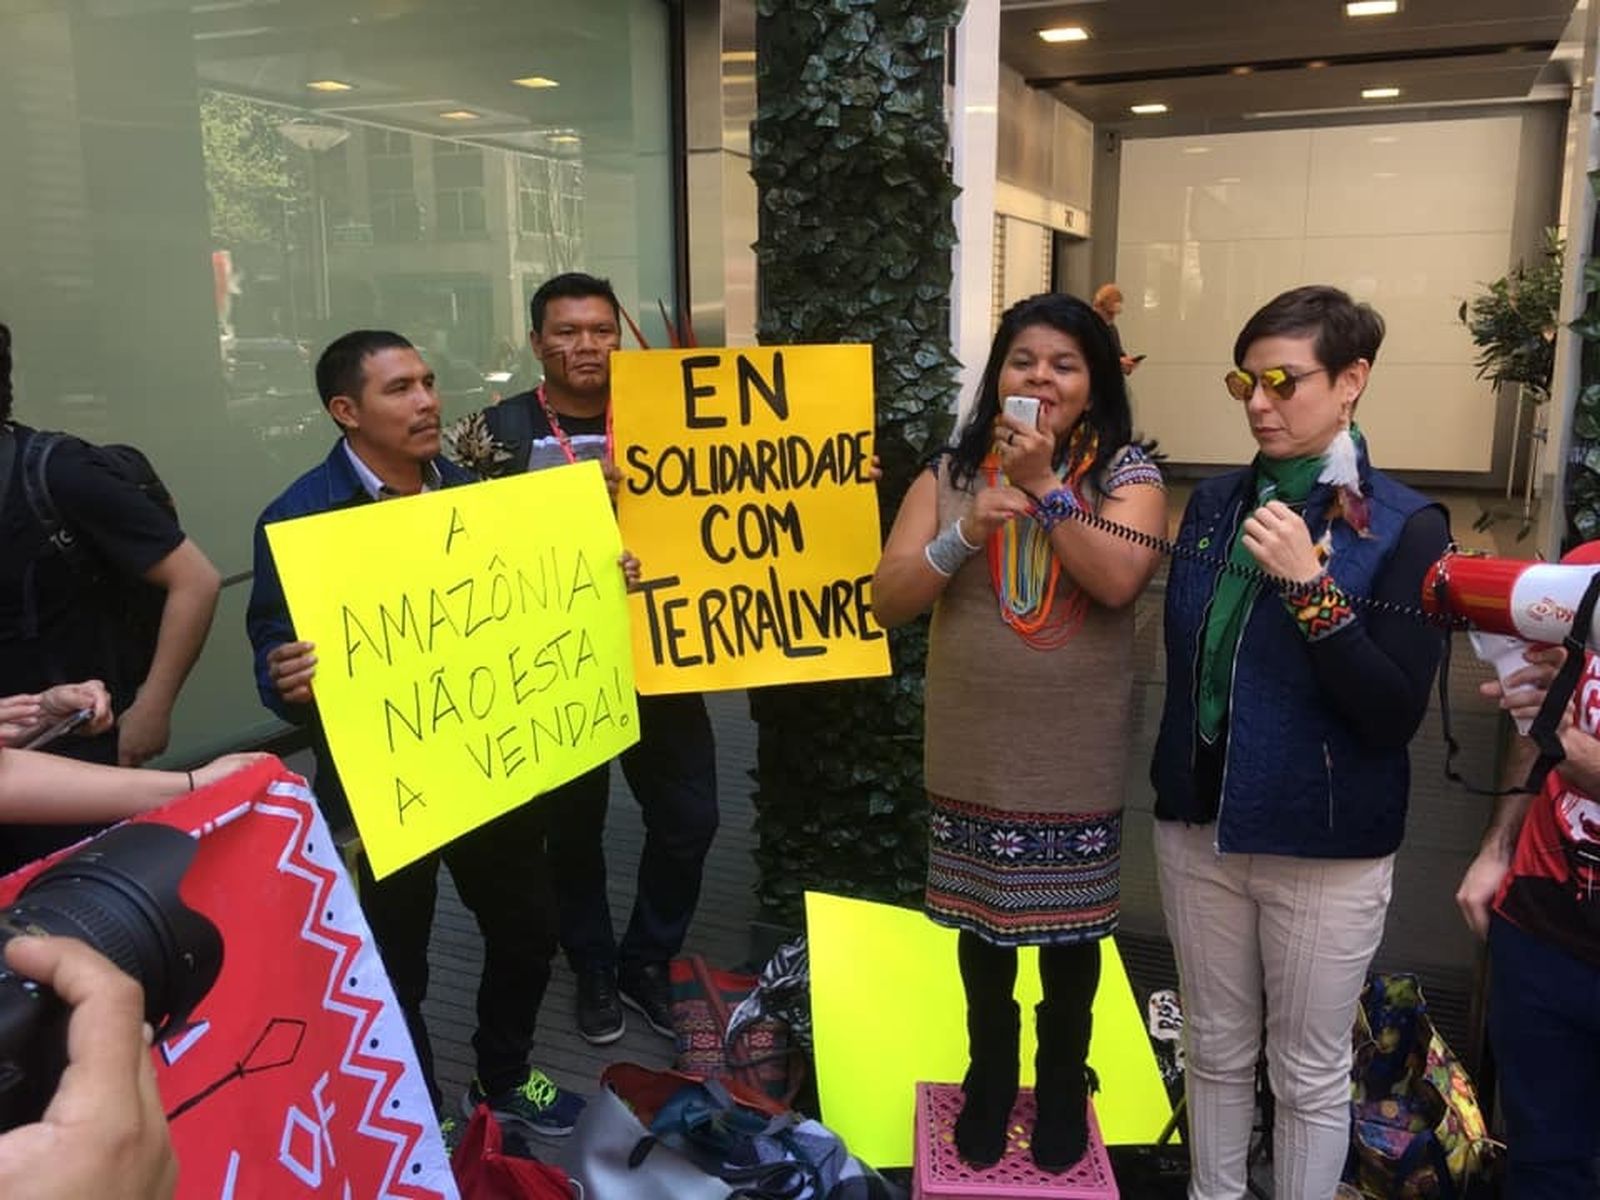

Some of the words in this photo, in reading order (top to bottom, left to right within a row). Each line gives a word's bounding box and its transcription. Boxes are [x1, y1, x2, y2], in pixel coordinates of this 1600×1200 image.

[681, 351, 789, 428] EN
[626, 431, 872, 496] SOLIDARIDADE
[445, 506, 469, 554] A
[700, 501, 804, 564] COM
[341, 546, 601, 678] AMAZÔNIA
[384, 665, 497, 753] NÃO
[508, 628, 599, 705] ESTA
[395, 777, 427, 825] A
[465, 667, 630, 779] VENDA!
